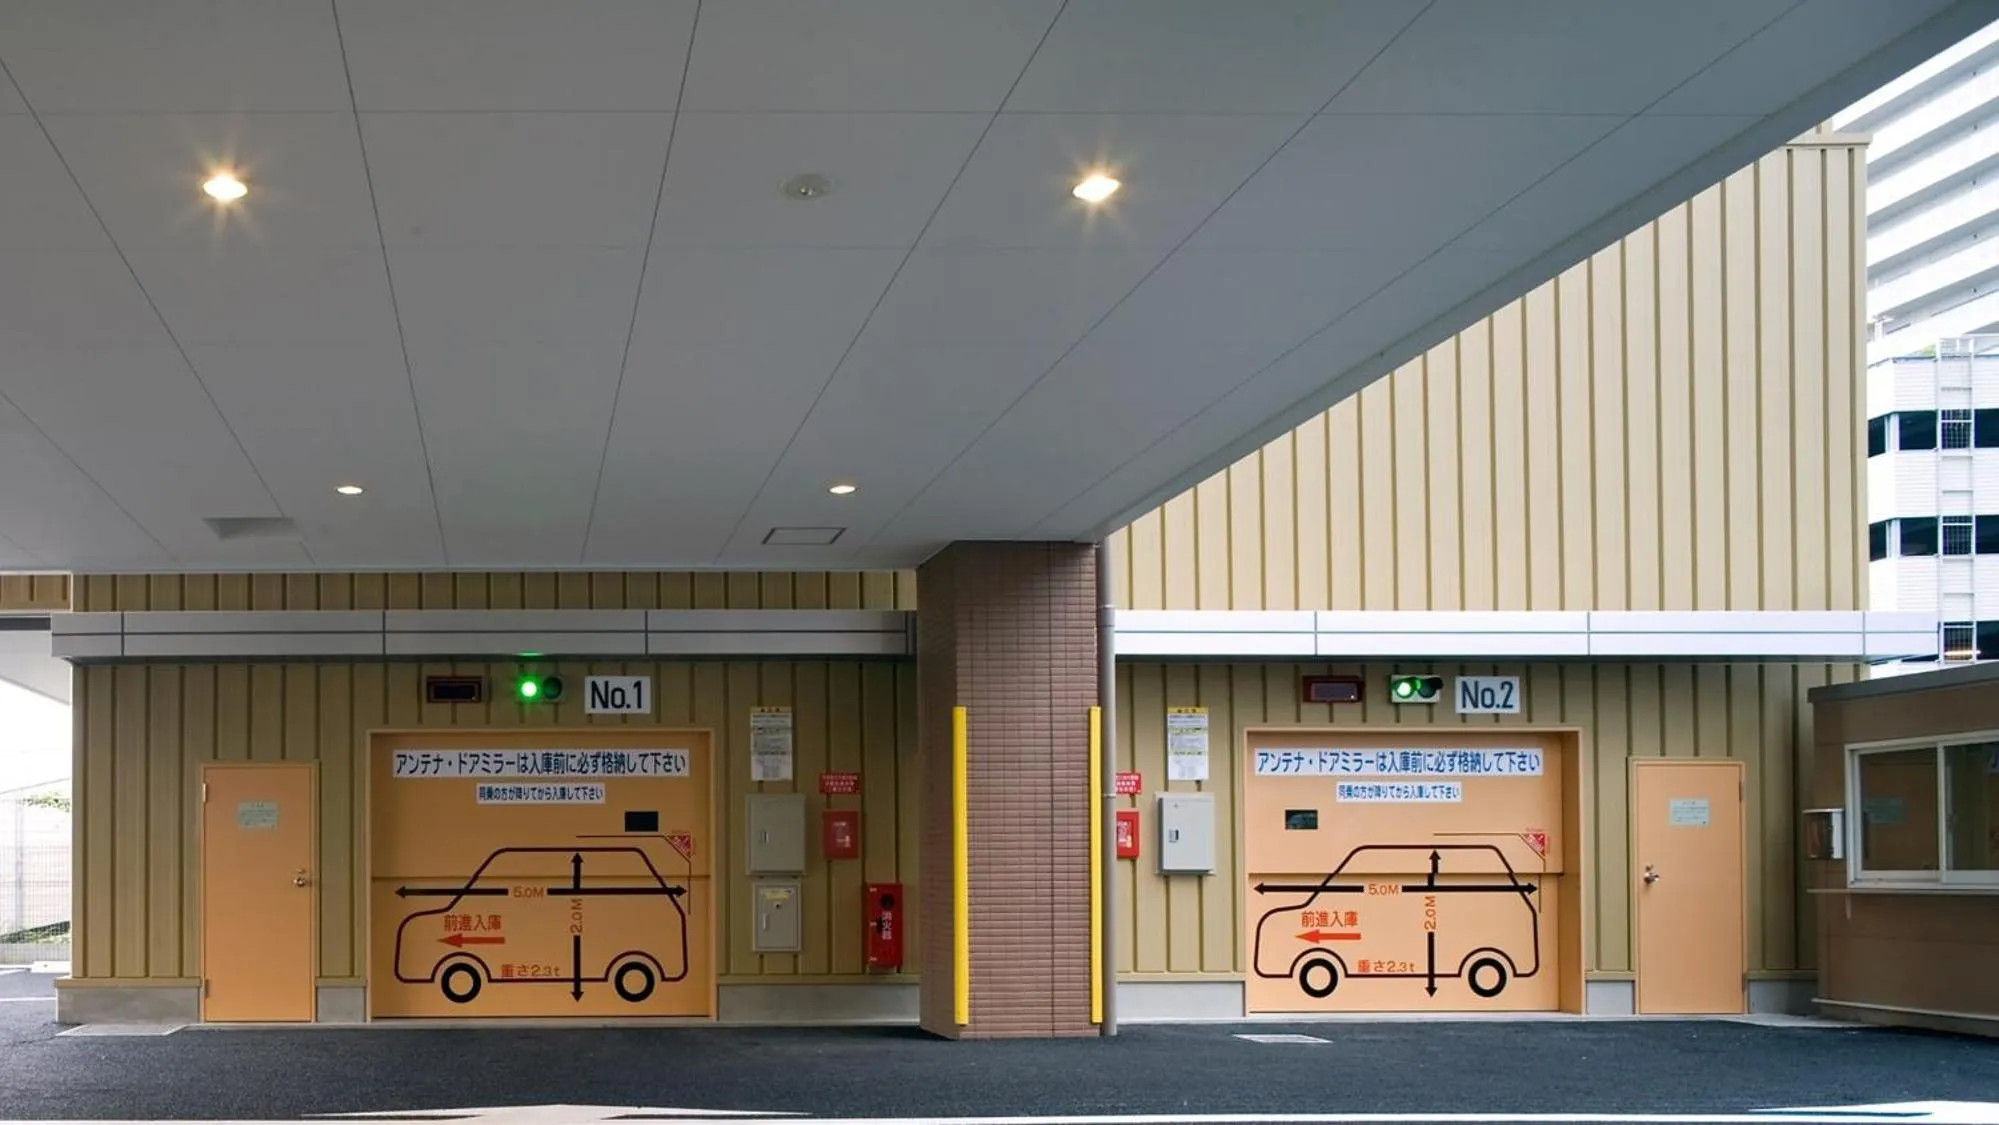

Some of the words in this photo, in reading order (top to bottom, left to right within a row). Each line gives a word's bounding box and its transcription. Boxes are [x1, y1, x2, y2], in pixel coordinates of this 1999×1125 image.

[590, 680, 642, 709] No.1
[1461, 680, 1514, 709] No.2
[395, 752, 686, 775] アンテナ・ドアミラーは入庫前に必ず格納して下さい
[1257, 751, 1541, 773] アンテナ・ドアミラーは入庫前に必ず格納して下さい
[512, 886, 545, 898] 5.0M
[1367, 883, 1399, 896] 5.0M
[443, 914, 502, 932] 前進入庫
[1300, 910, 1359, 928] 前進入庫
[1423, 895, 1437, 931] 2.0M
